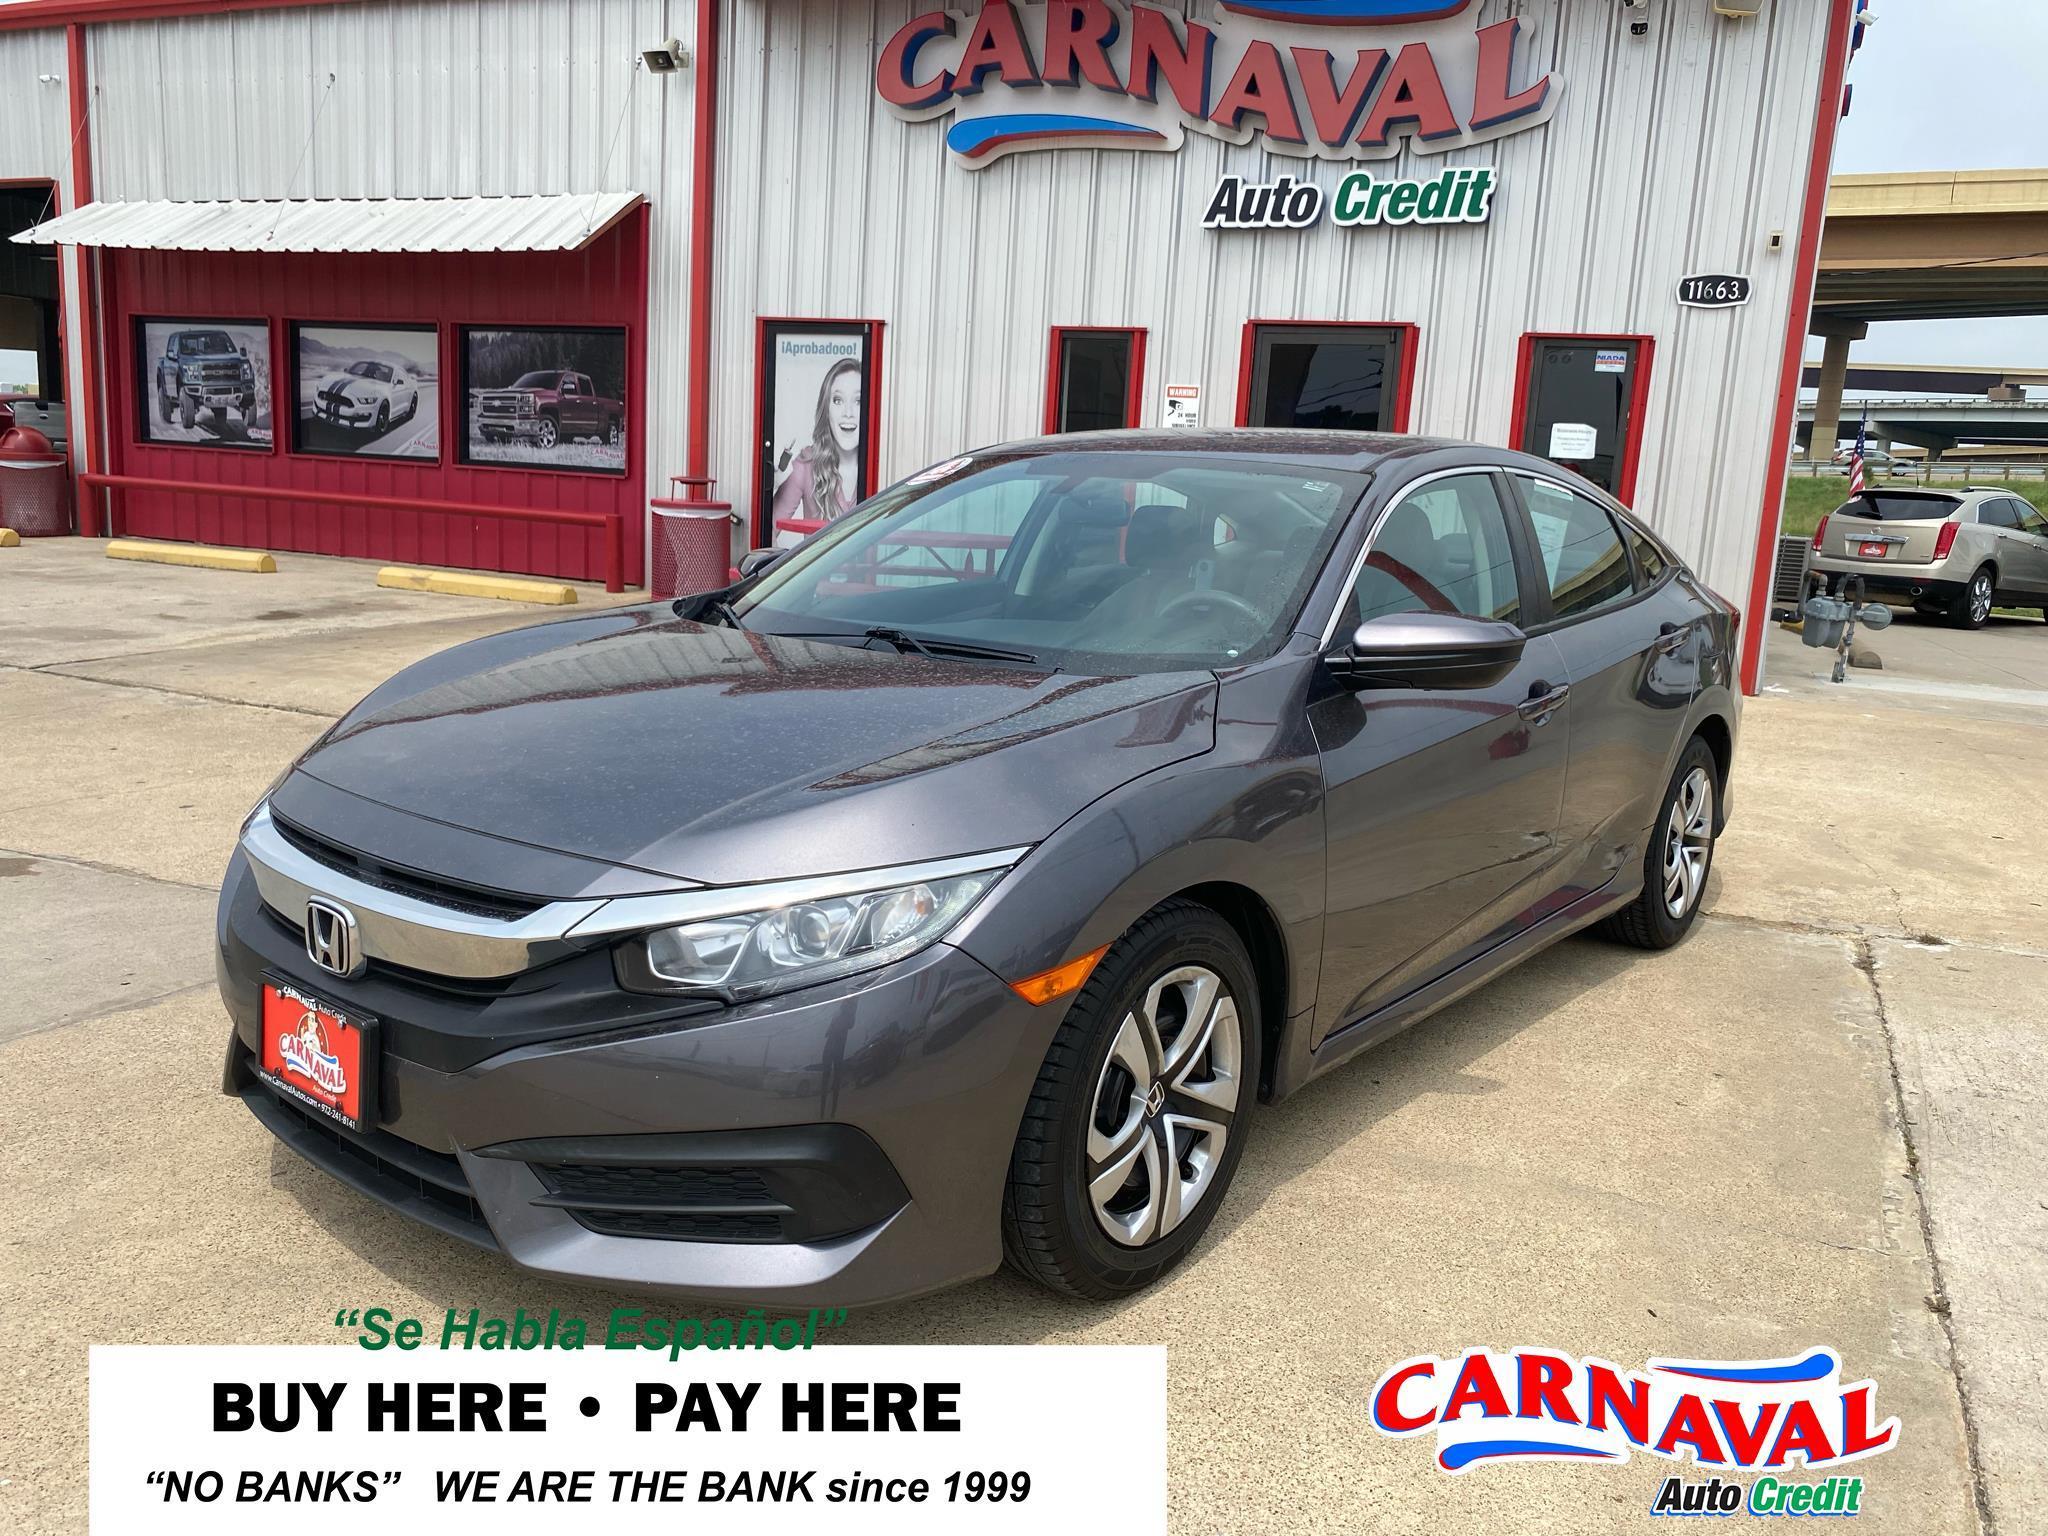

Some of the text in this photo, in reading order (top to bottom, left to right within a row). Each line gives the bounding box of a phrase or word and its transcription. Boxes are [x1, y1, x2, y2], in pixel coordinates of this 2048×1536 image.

[876, 0, 1552, 148] CARNAVAL
[1203, 170, 1491, 225] Auto Credit
[1688, 281, 1739, 299] 11663
[781, 341, 857, 357] ¡Aprobadooo!
[1168, 388, 1197, 397] WARNING
[280, 1034, 345, 1088] CARNAVAL
